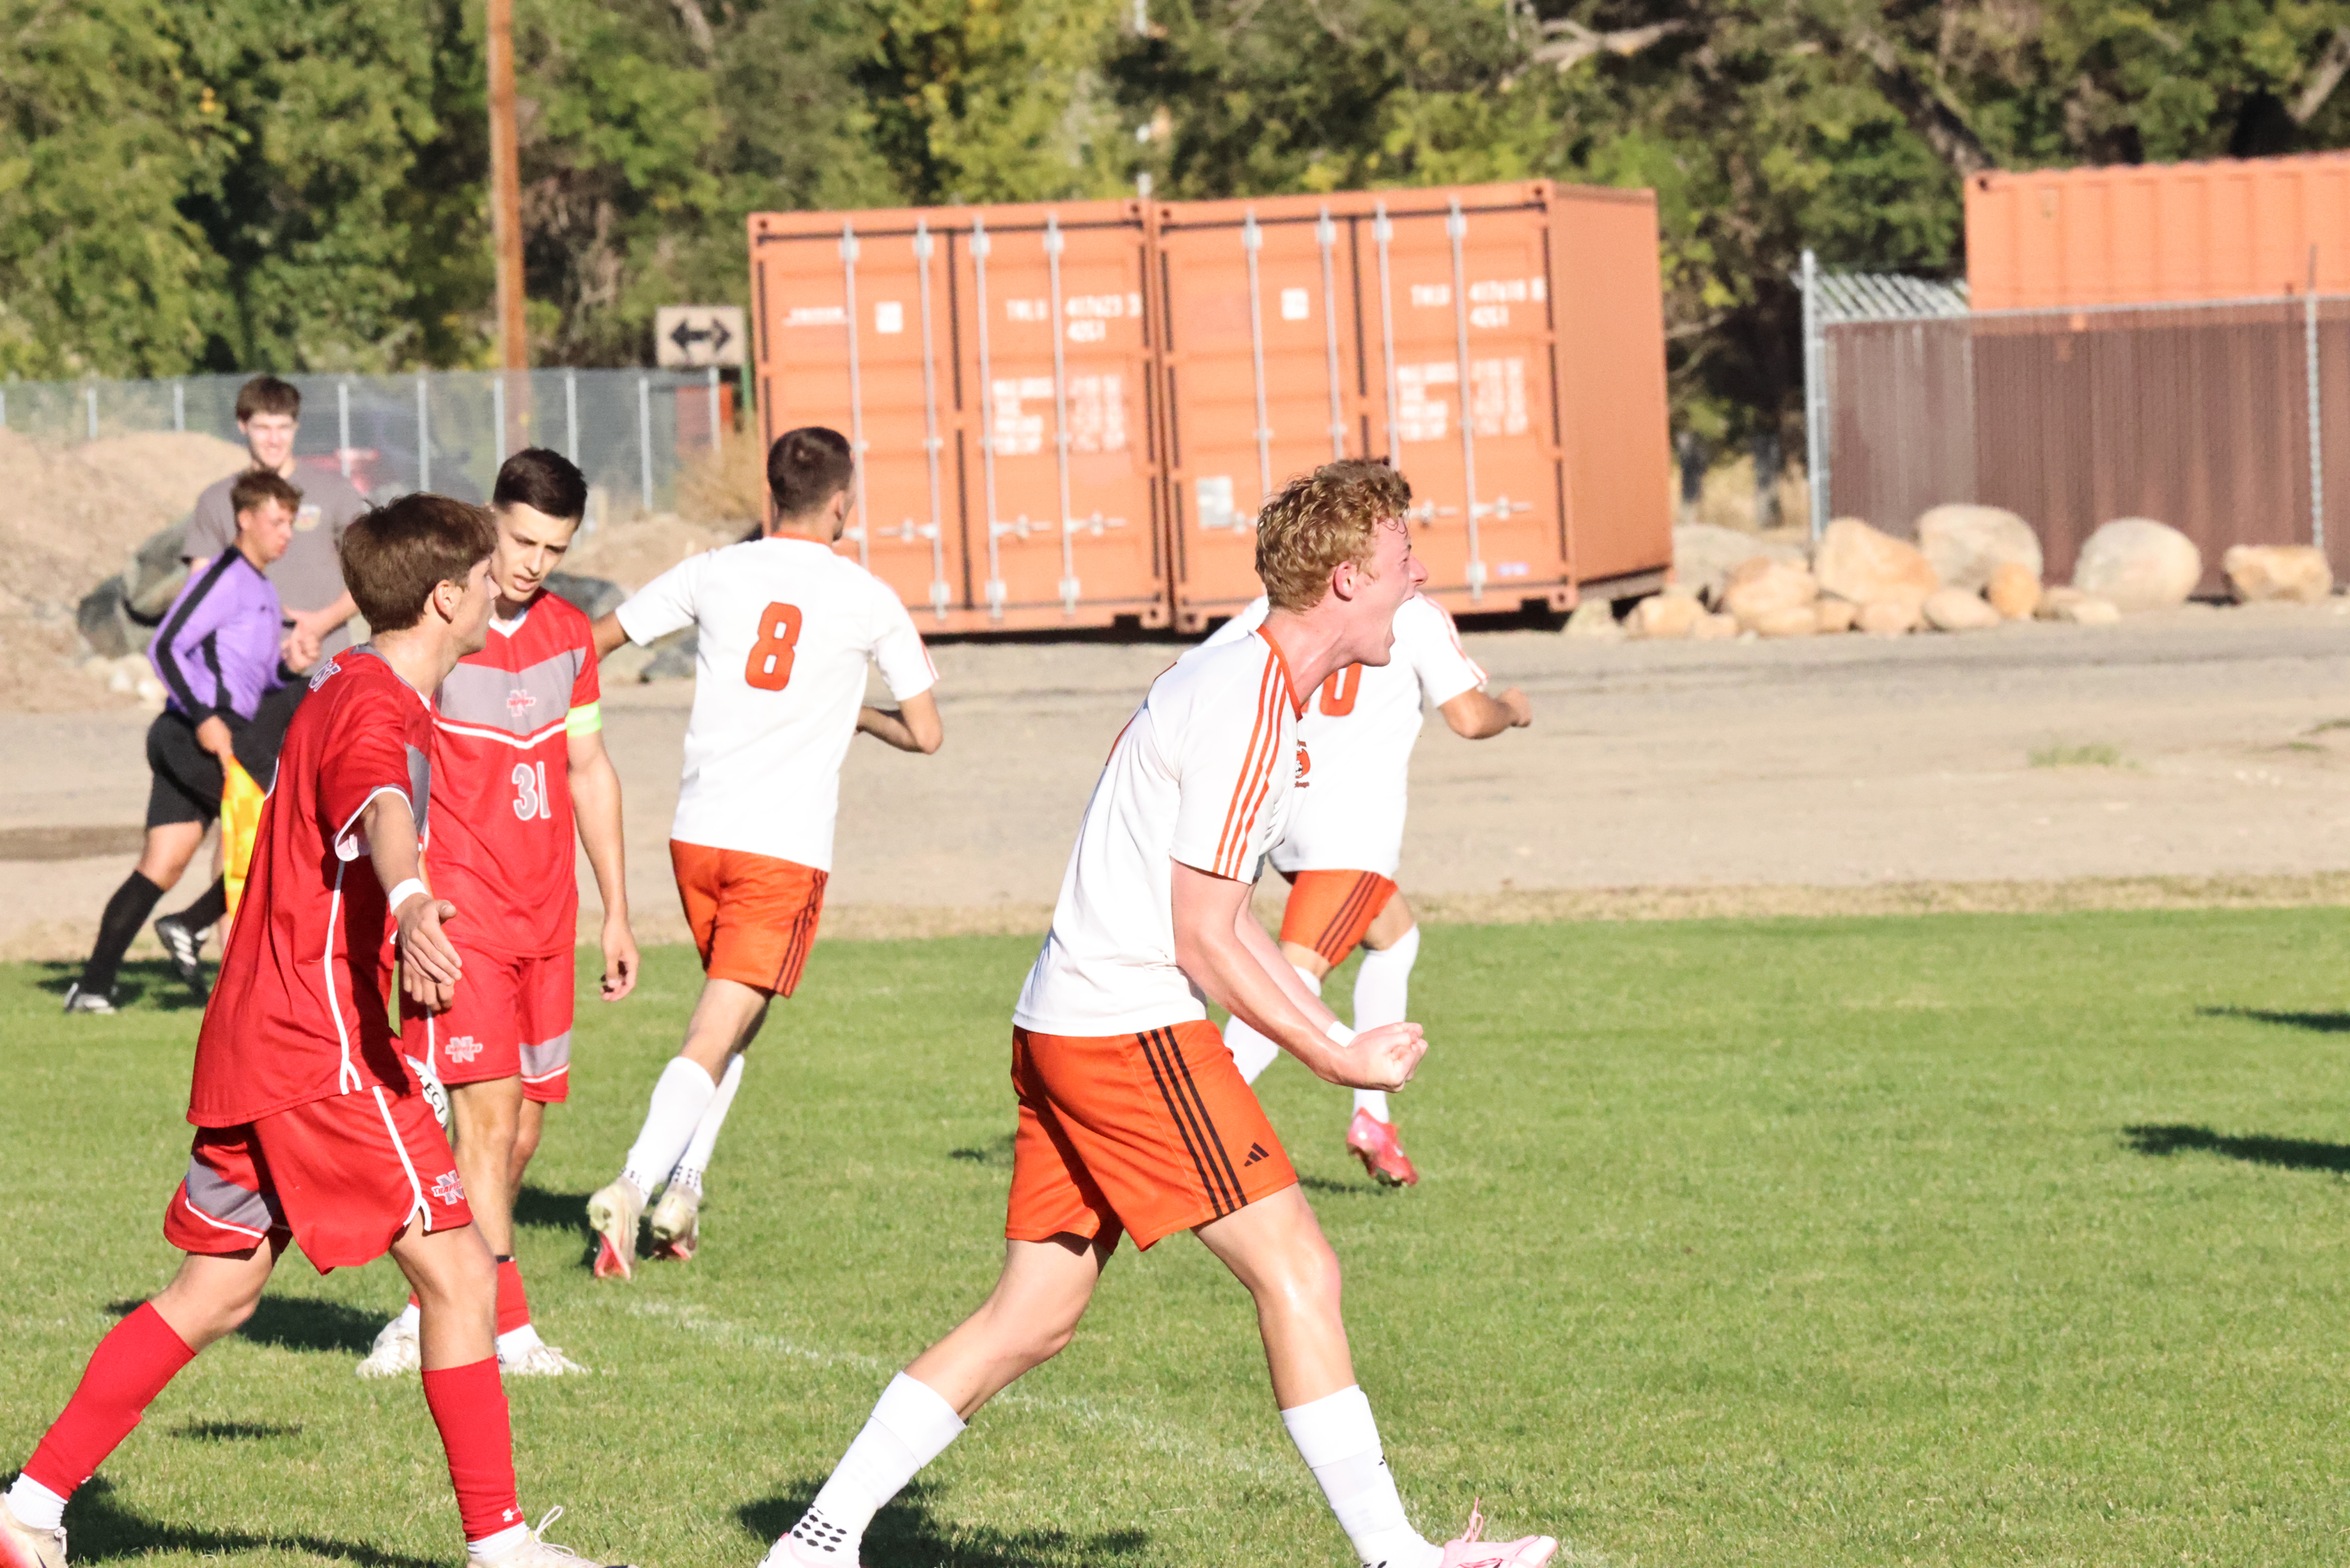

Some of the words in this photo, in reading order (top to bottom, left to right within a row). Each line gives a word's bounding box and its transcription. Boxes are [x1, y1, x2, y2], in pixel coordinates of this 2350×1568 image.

[745, 601, 802, 691] 8
[1301, 662, 1362, 716] 0
[512, 761, 551, 821] 31
